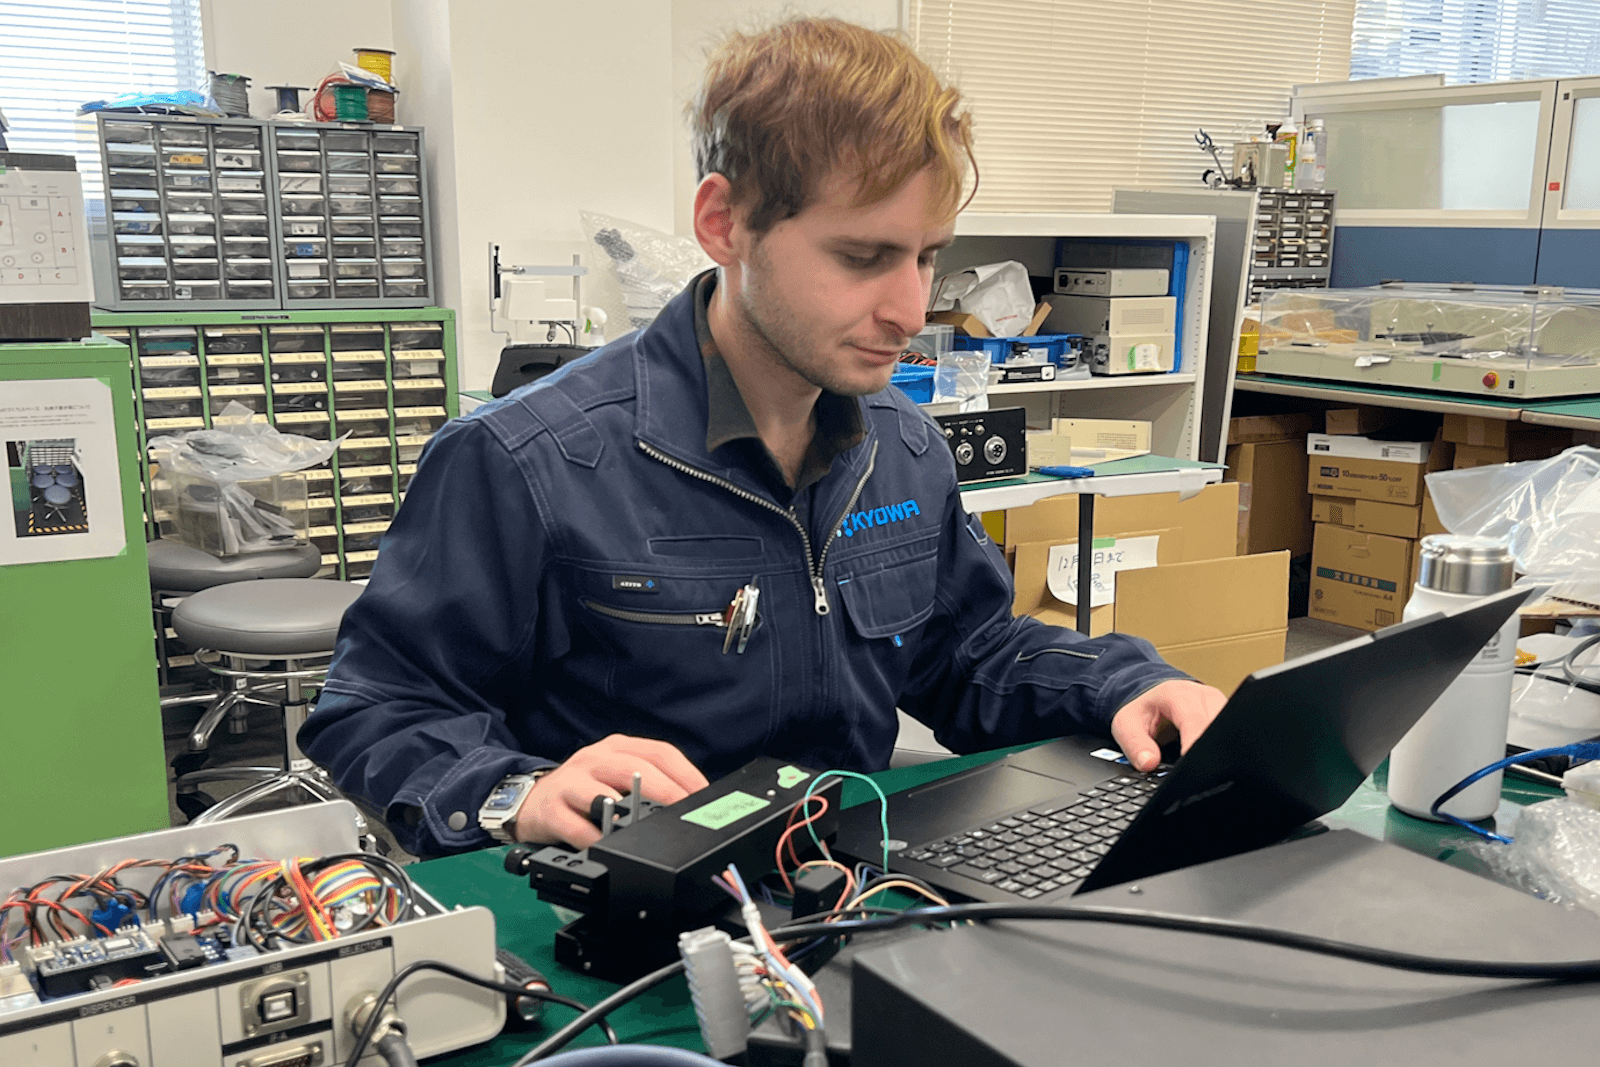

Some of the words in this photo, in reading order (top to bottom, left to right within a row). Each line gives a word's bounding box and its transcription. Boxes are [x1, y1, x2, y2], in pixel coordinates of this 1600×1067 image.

[850, 499, 920, 531] KYOWA
[1058, 551, 1125, 572] 12月日まで
[339, 939, 384, 957] SELECTOR
[264, 963, 283, 974] USB
[108, 1026, 114, 1034] 2
